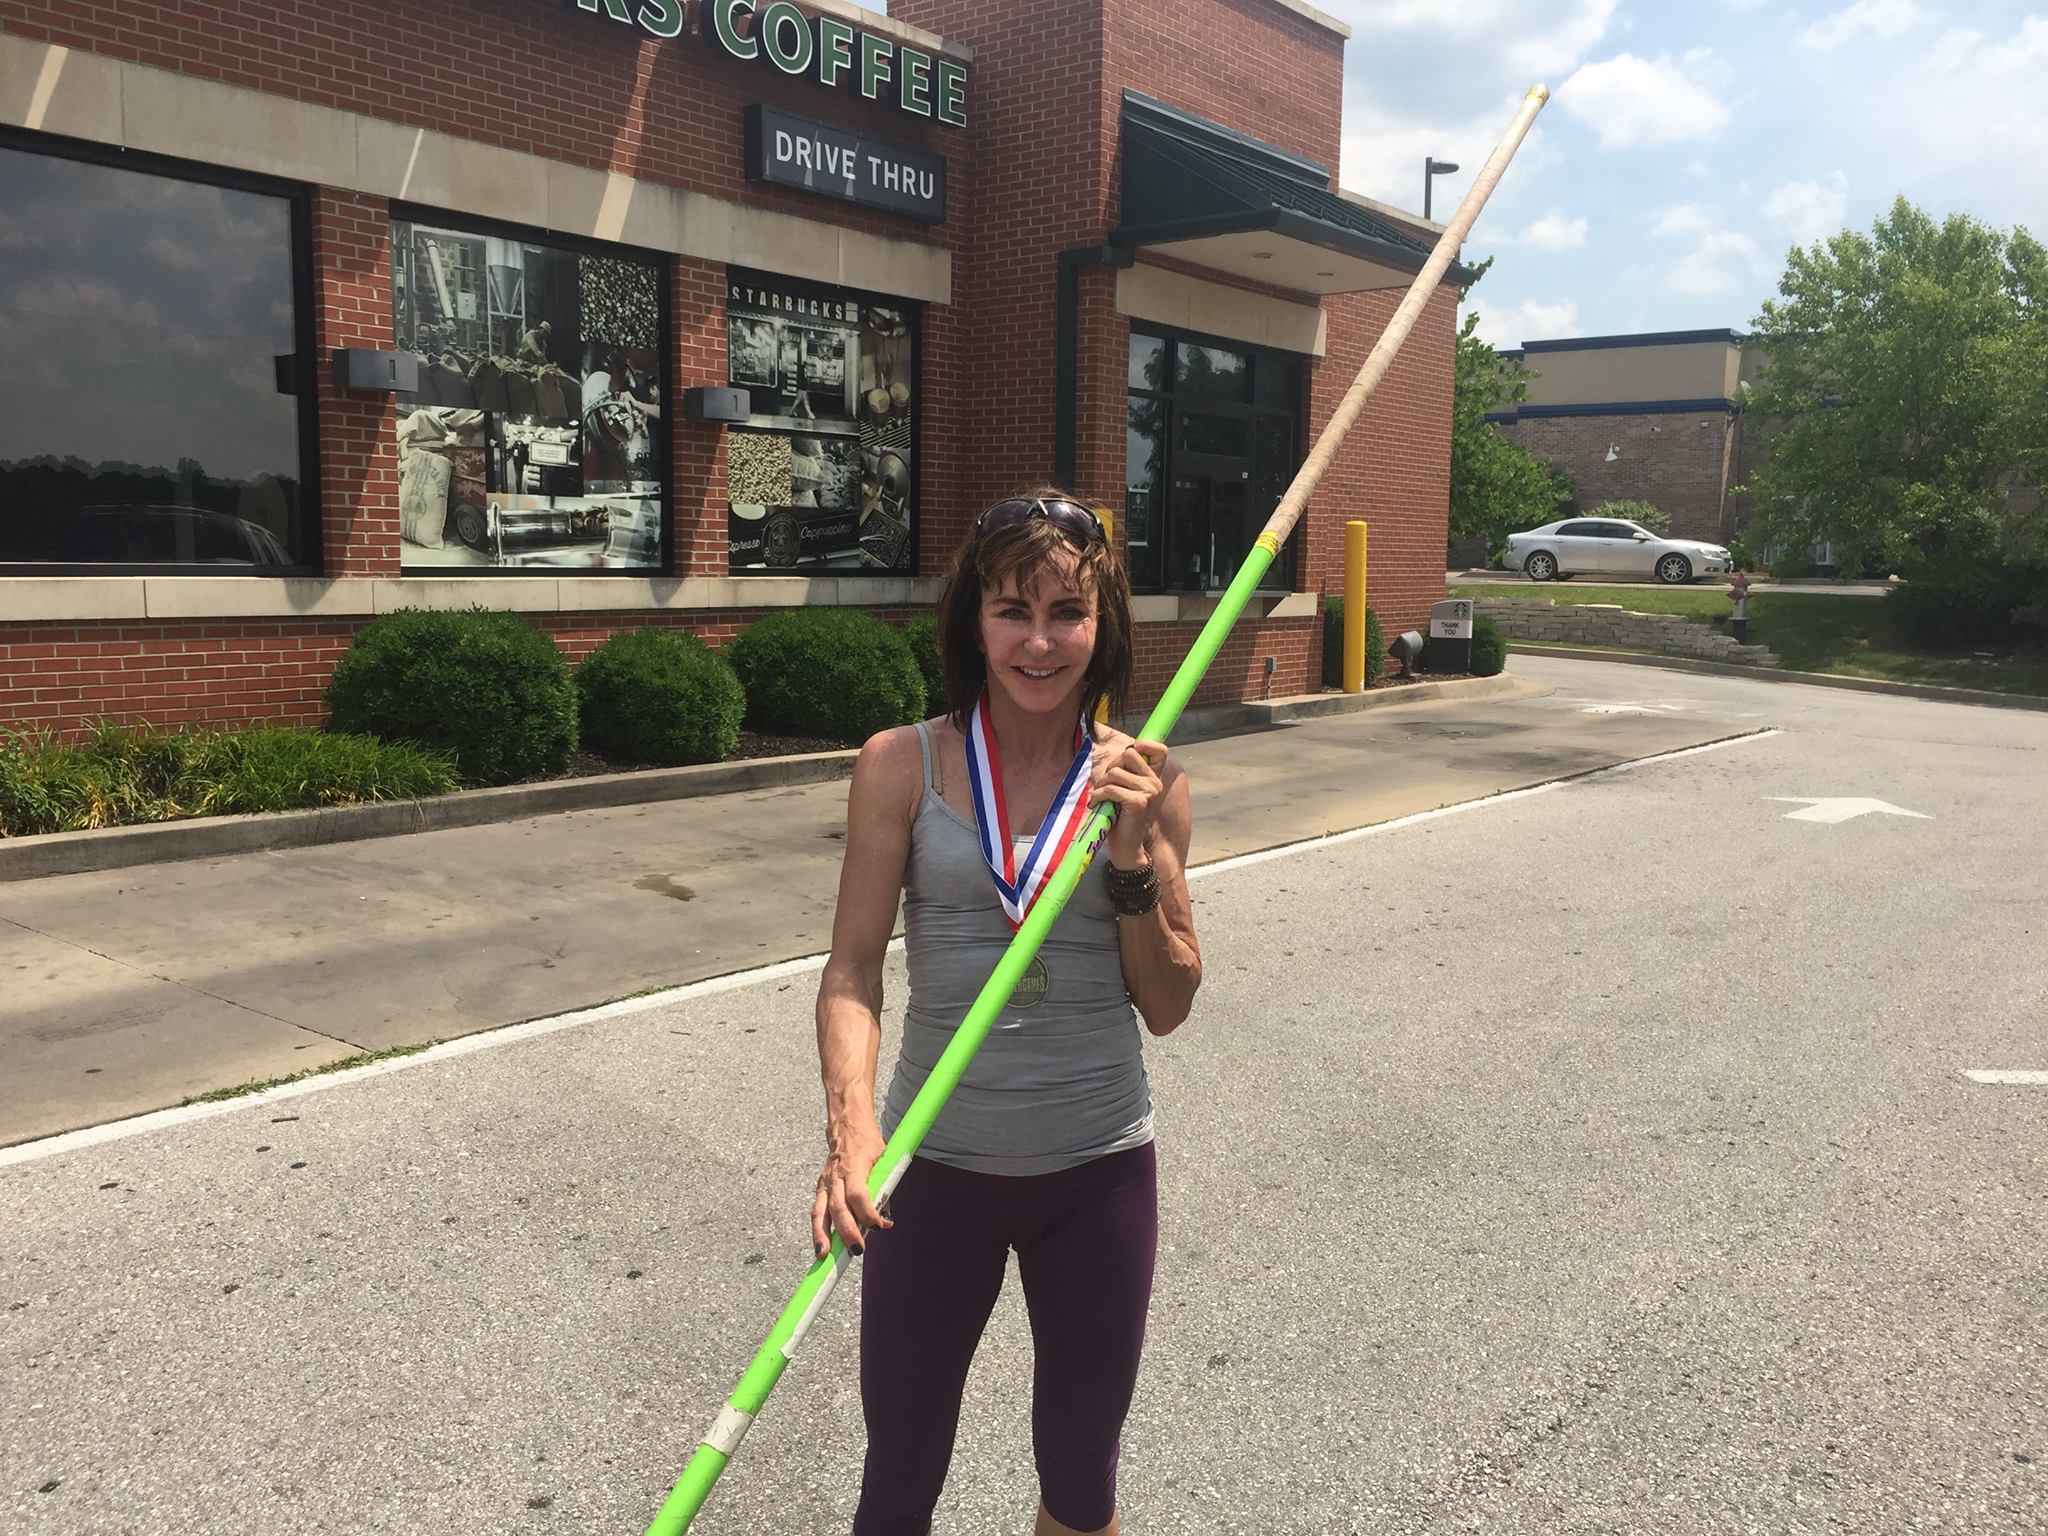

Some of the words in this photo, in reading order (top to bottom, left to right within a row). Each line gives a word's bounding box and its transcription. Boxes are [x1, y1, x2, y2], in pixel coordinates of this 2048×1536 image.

[713, 0, 967, 128] COFFEE
[775, 130, 857, 181] DRIVE
[867, 156, 935, 200] THRU
[732, 286, 842, 320] STARBUCKS
